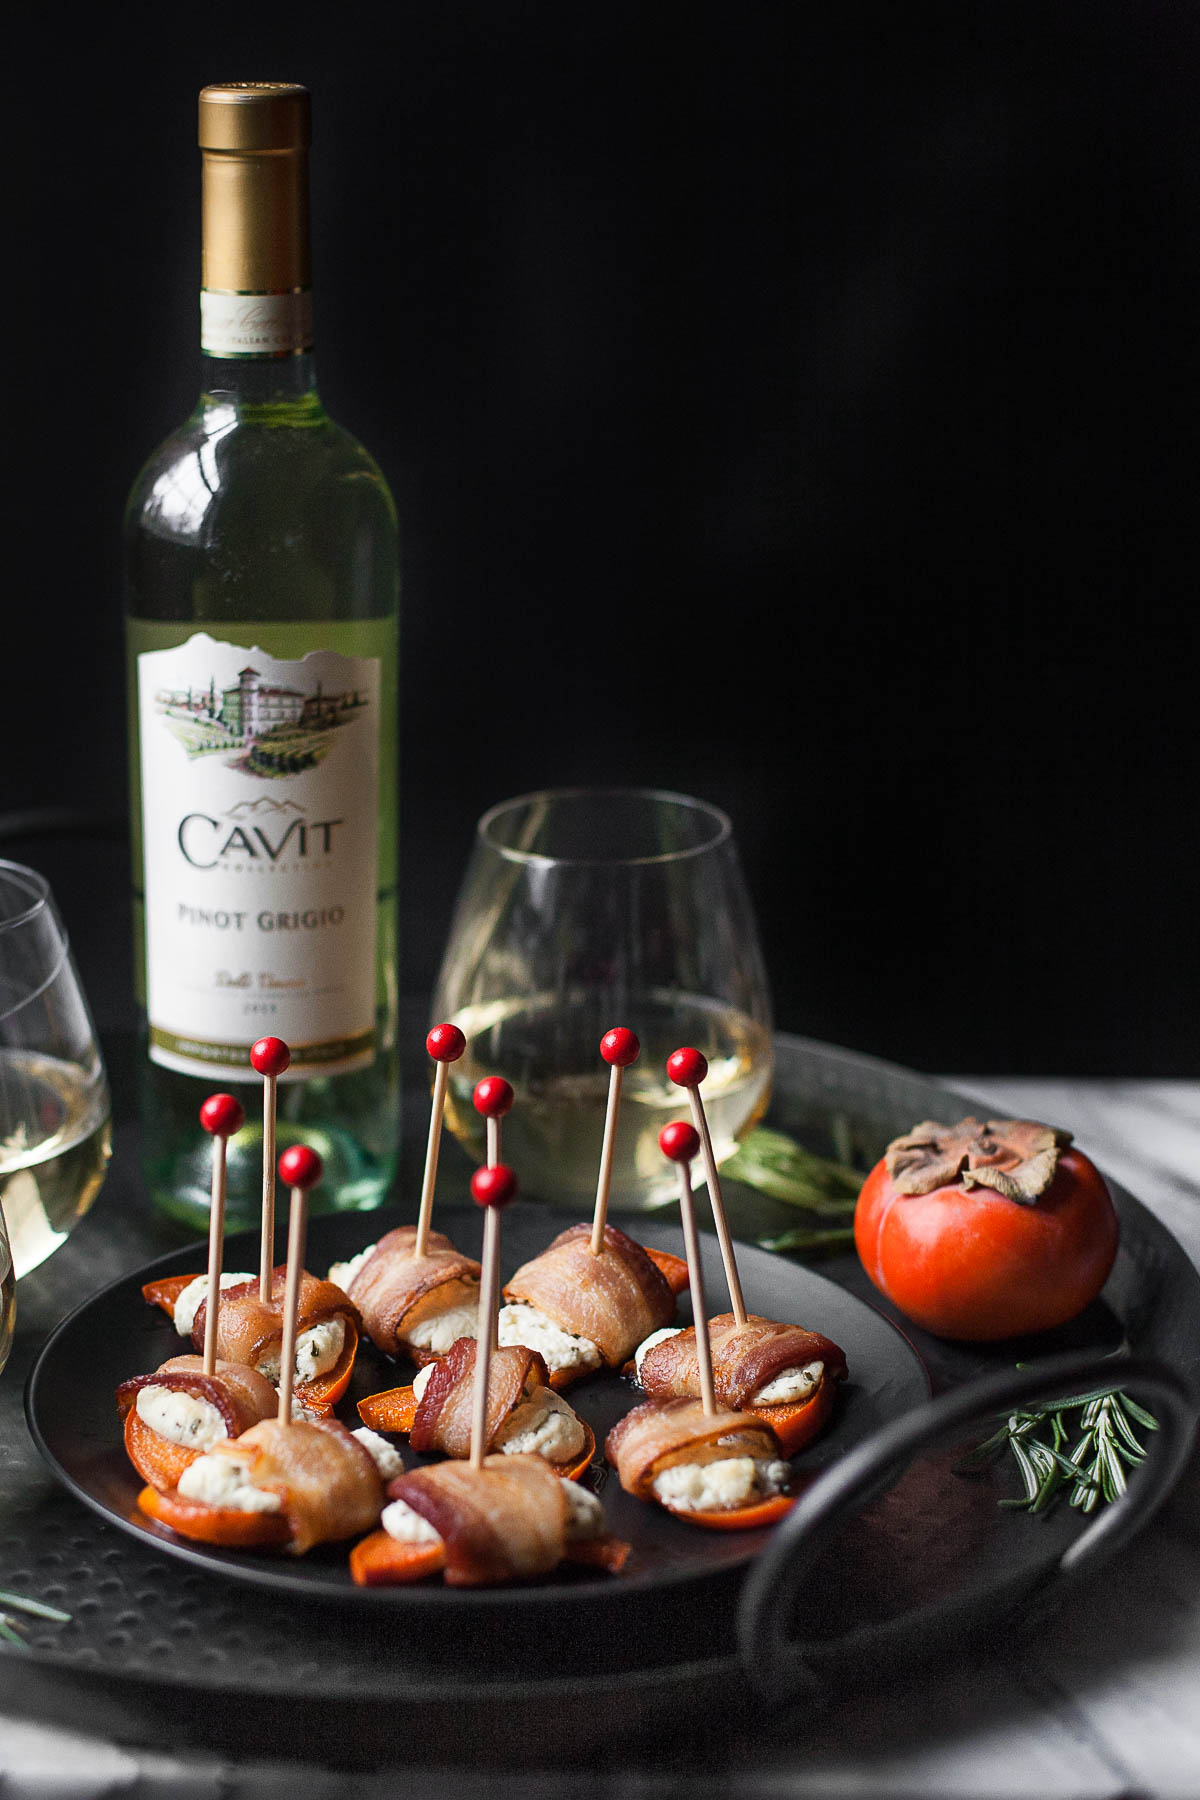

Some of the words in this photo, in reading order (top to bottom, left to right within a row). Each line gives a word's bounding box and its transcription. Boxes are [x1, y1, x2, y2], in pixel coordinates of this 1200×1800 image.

[178, 814, 343, 869] CAVIT
[178, 902, 246, 931] PINOT
[257, 905, 346, 932] GRIGIO
